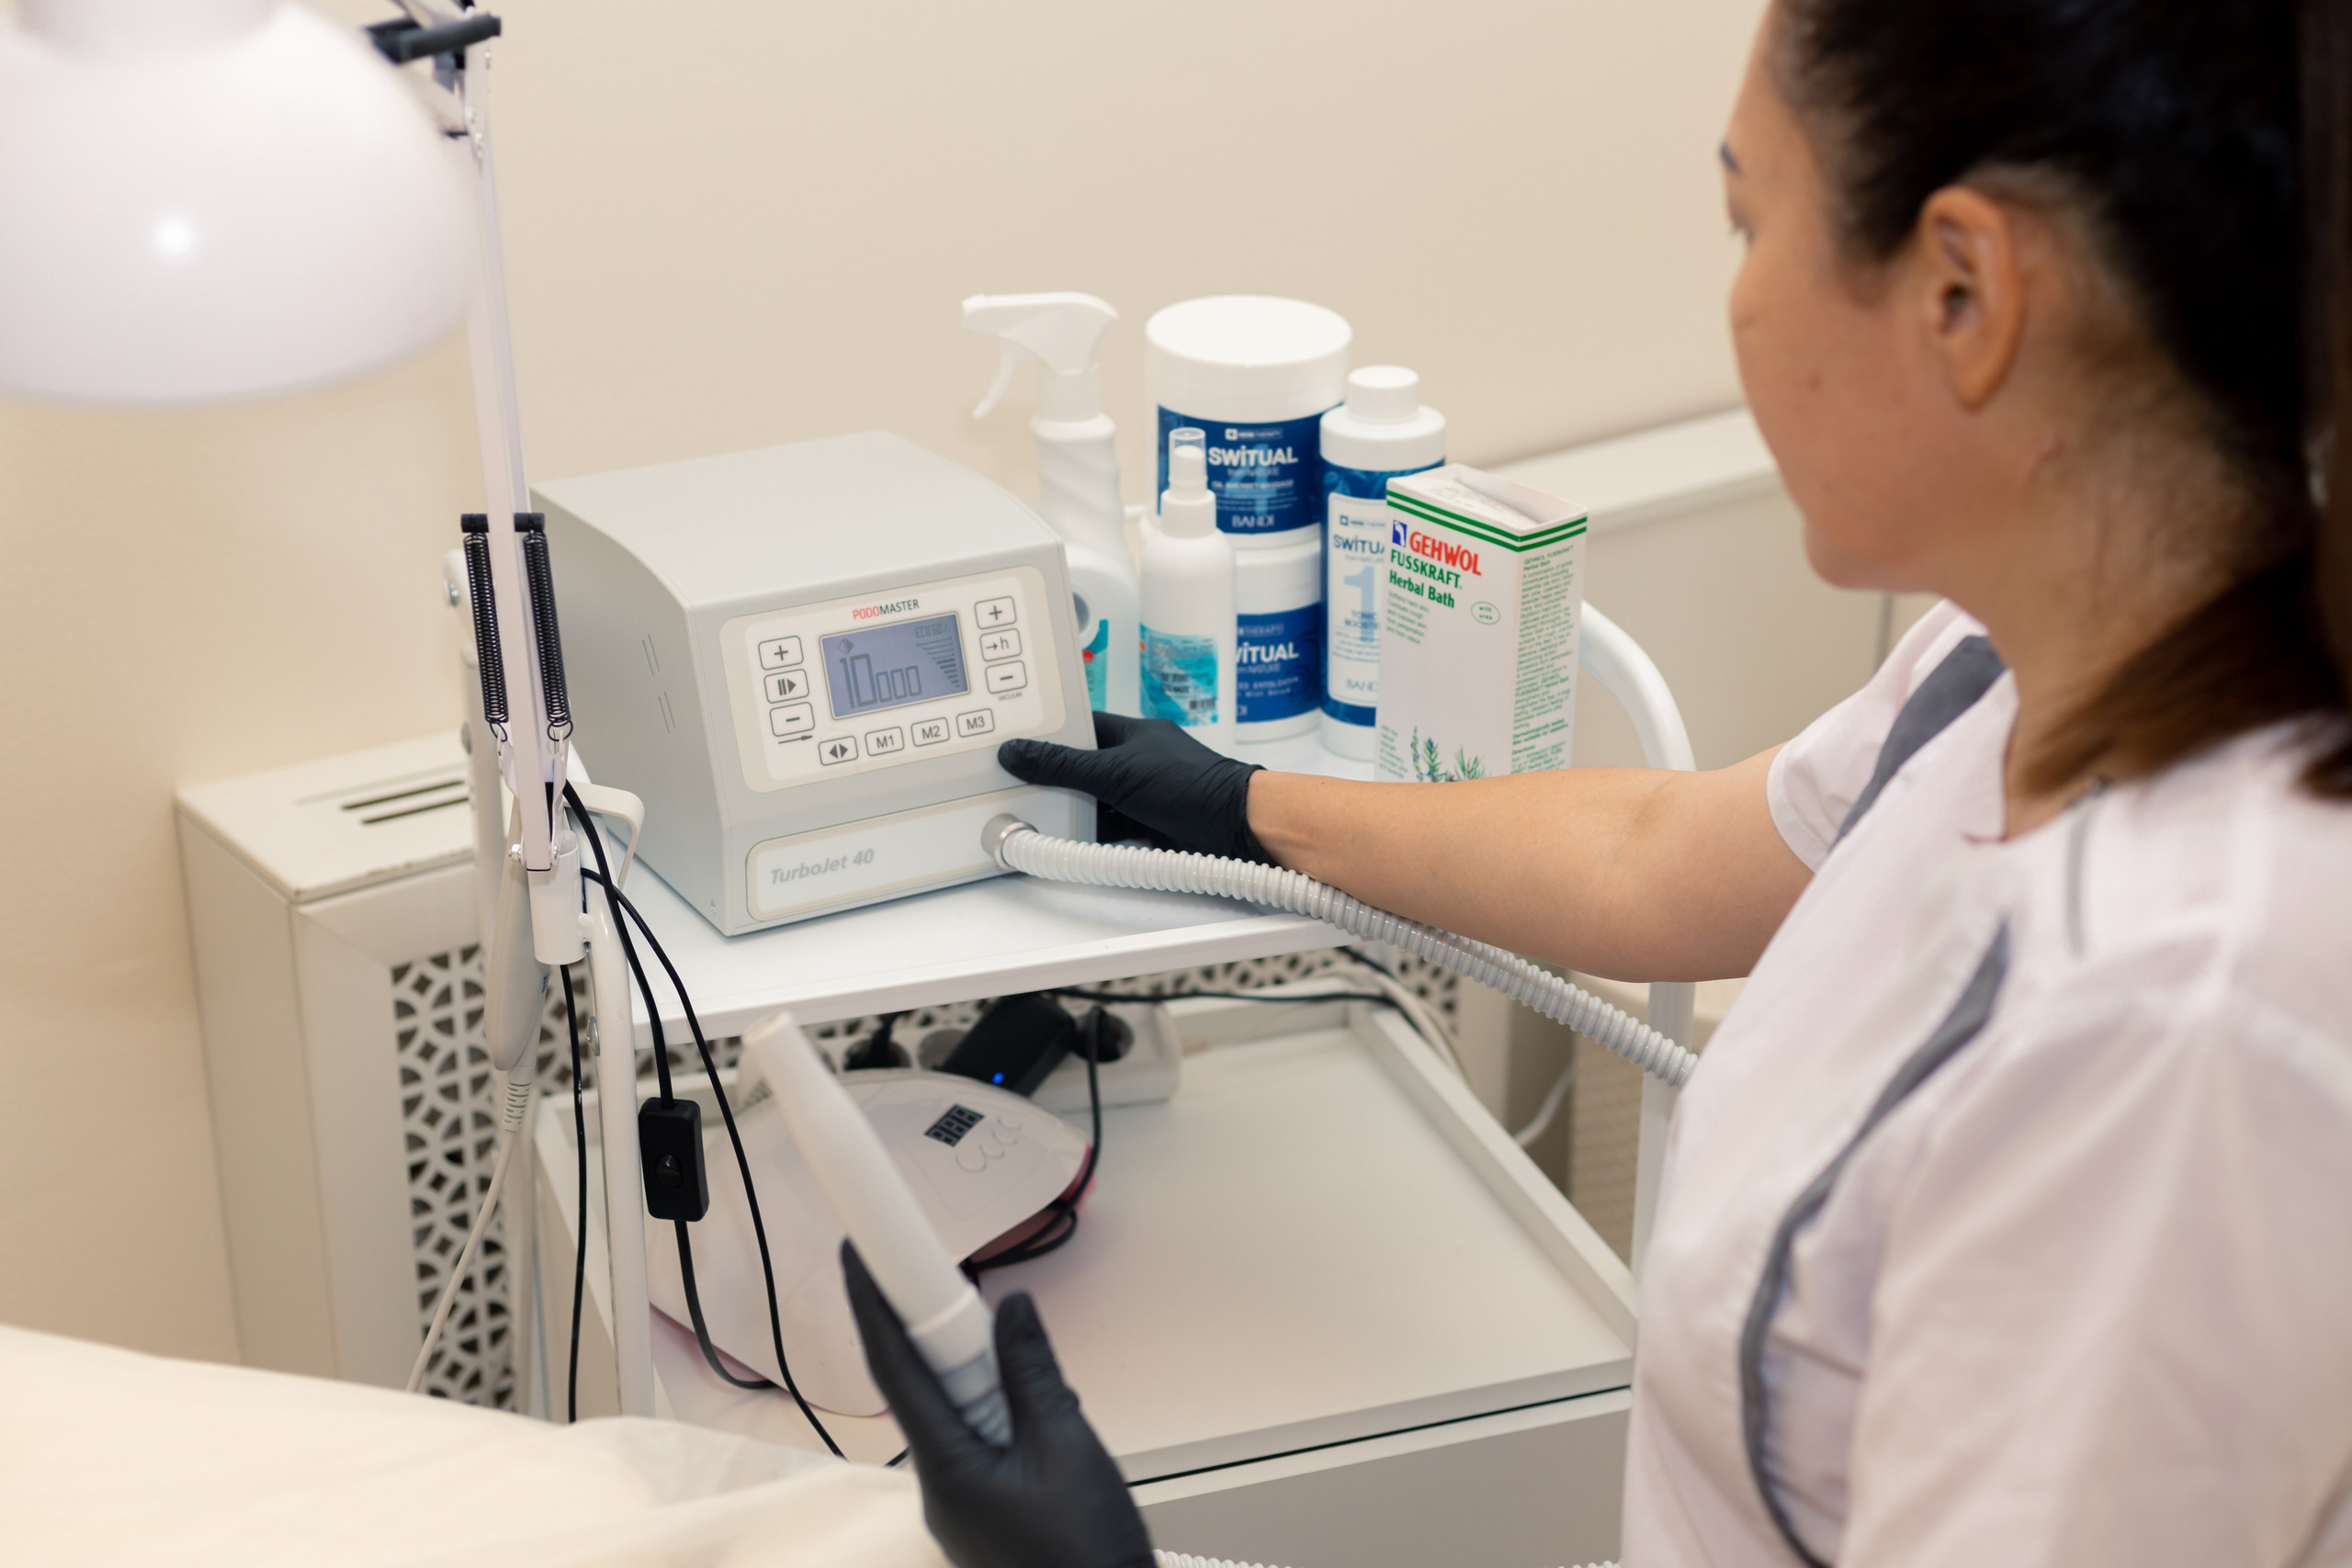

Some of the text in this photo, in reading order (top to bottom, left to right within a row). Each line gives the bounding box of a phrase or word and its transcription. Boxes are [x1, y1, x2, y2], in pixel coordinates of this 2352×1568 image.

[1409, 531, 1482, 576] GEHWOL
[1389, 569, 1455, 609] Herbal Bath
[853, 599, 921, 621] PODOMASTER
[922, 725, 941, 739] M2
[967, 716, 986, 730] M3
[876, 734, 895, 749] M1
[770, 848, 875, 885] TurboJet 40
